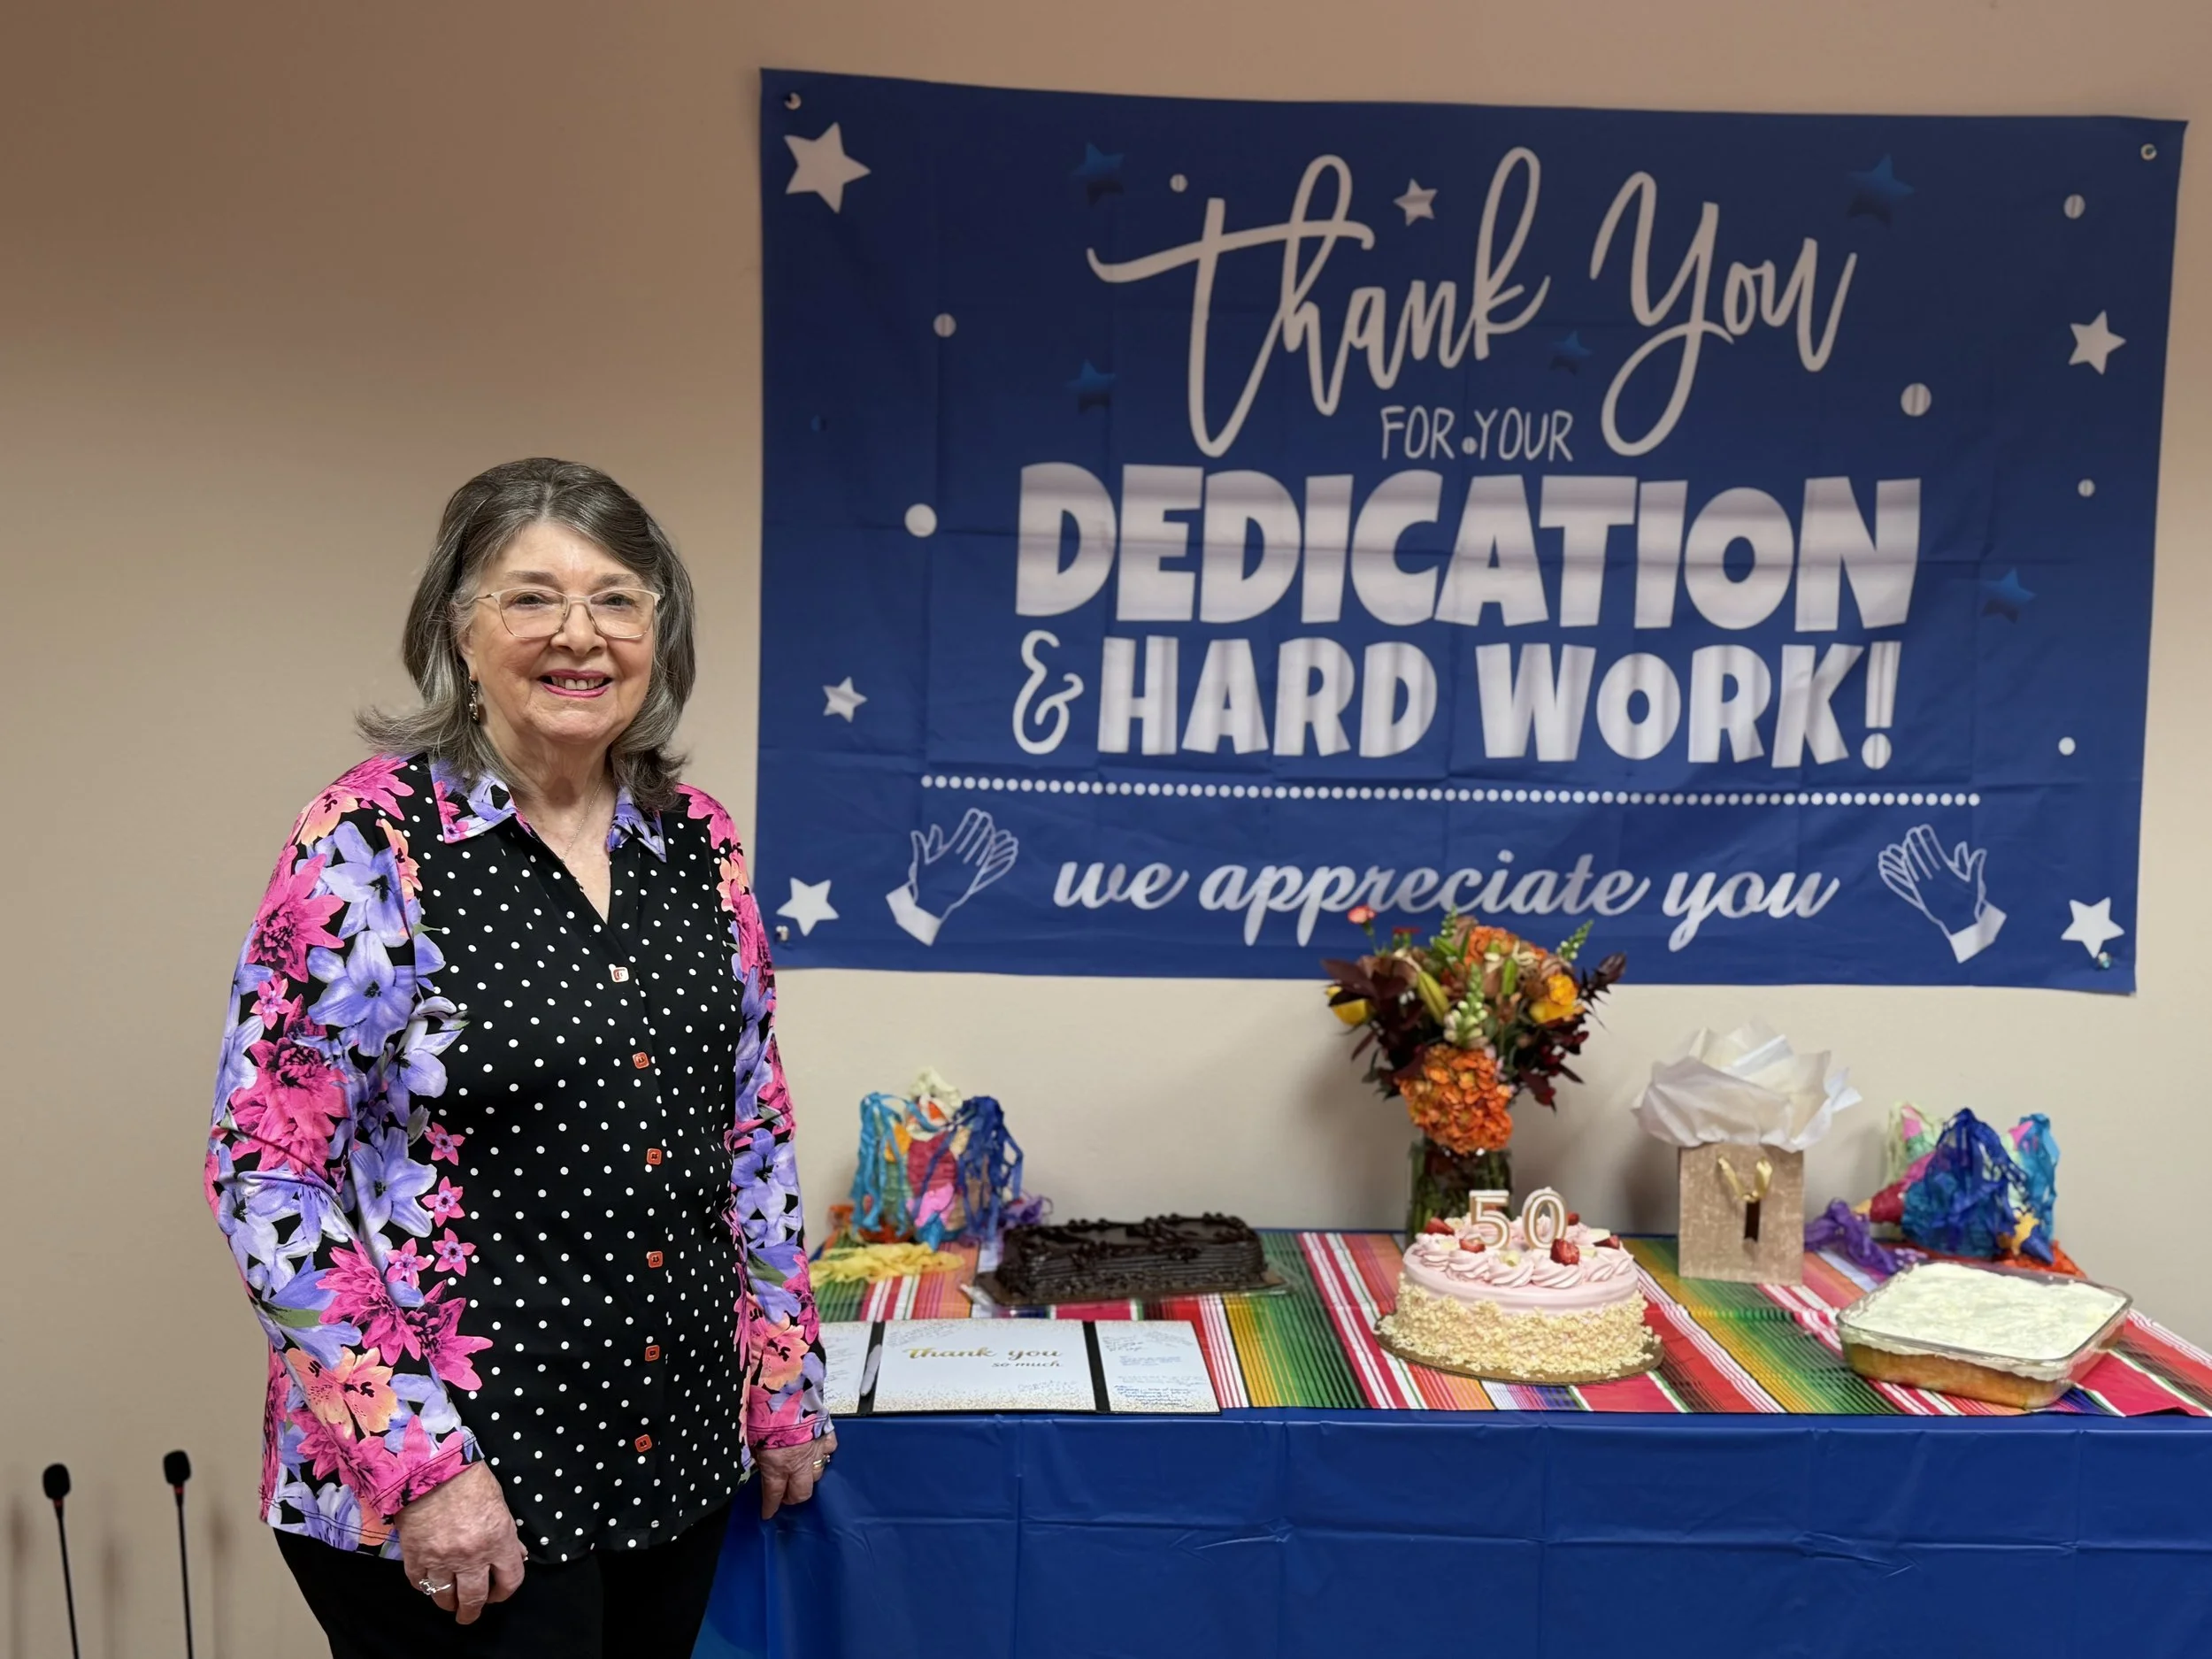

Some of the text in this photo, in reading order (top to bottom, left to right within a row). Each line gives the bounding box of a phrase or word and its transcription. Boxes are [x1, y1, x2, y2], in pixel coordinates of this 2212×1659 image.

[1379, 404, 1574, 463] FOR YOUR
[1014, 461, 1922, 634] DEDICATION
[1011, 628, 1903, 771] & HARD WORK!
[1052, 849, 1841, 953] we appreciate you
[1468, 1187, 1568, 1251] 50
[902, 1347, 1063, 1361] Thank you
